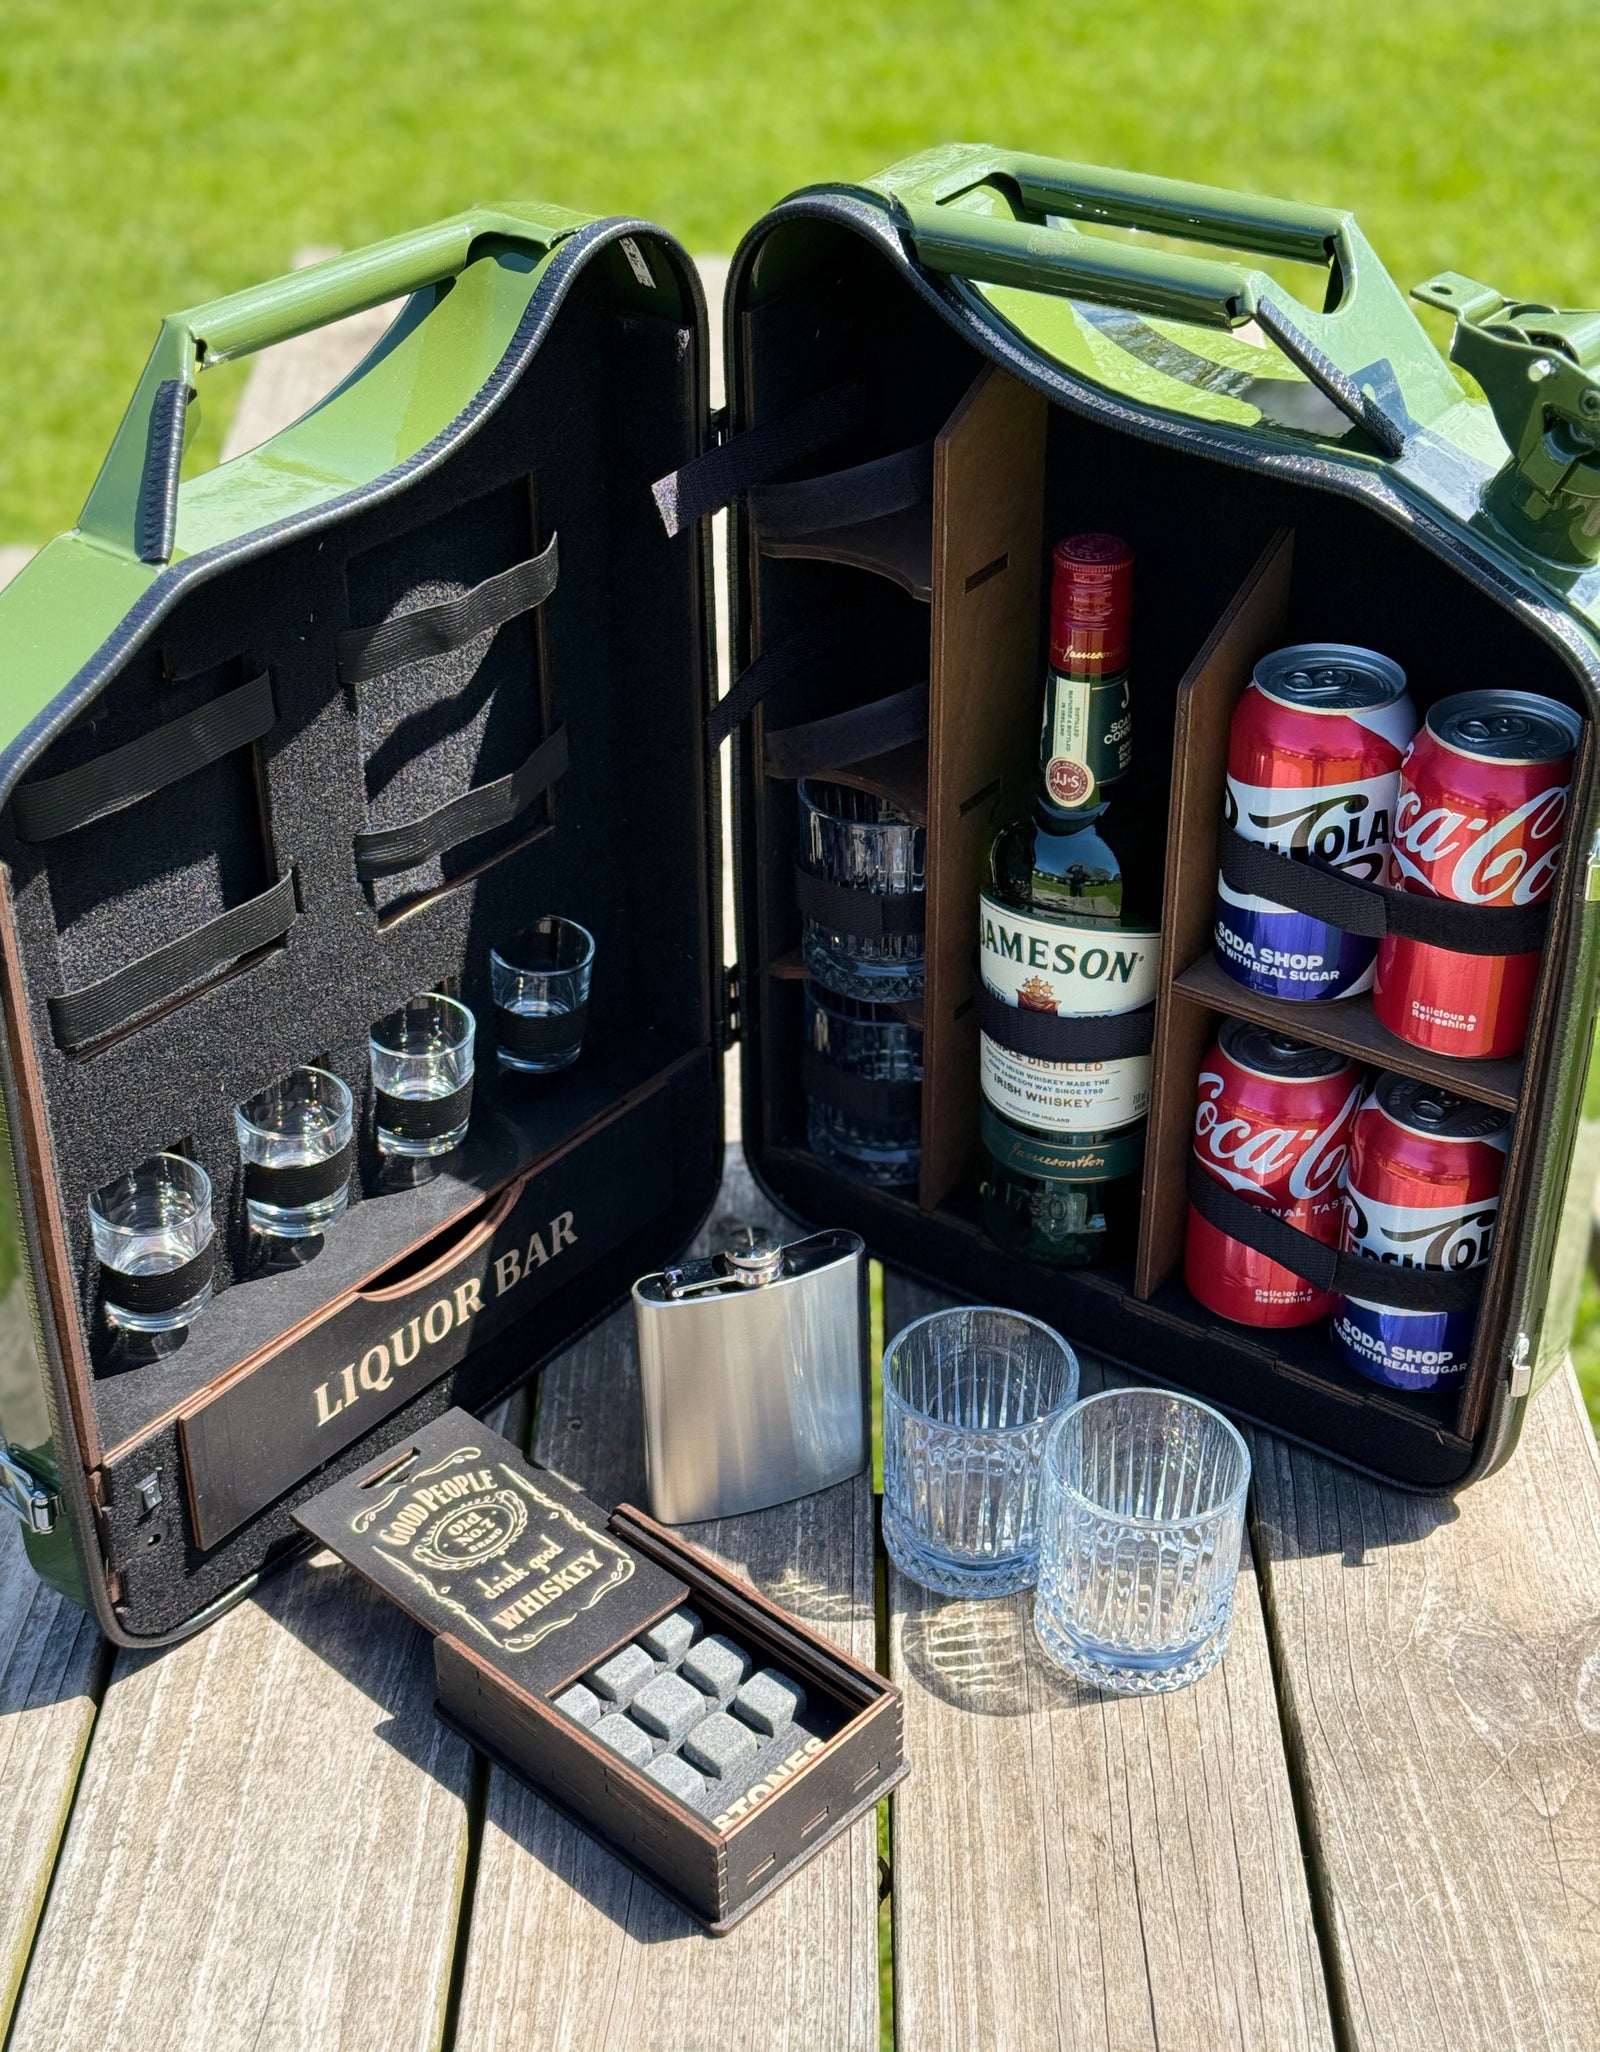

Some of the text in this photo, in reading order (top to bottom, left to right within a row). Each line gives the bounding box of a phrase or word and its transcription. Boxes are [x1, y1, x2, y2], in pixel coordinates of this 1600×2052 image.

[1218, 921, 1323, 970] SODA SHOP
[1226, 946, 1251, 969] WITH
[1252, 962, 1287, 979] REAL
[1289, 970, 1340, 982] SUGAR
[1411, 1009, 1475, 1032] Refreshing
[1412, 1000, 1477, 1023] Delicious &
[1006, 1064, 1025, 1076] IRISH
[1027, 1073, 1064, 1086] WHISKEY
[1028, 1056, 1103, 1072] DISTILLED
[993, 1072, 1093, 1108] IRISH WHISKEY
[1001, 1070, 1033, 1087] JAMESON
[1035, 1084, 1052, 1093] WAY
[1055, 1087, 1081, 1095] SINCE
[1005, 1101, 1031, 1116] PRODUCT
[1042, 1114, 1070, 1123] IRELAND
[1312, 1199, 1345, 1214] TAS
[1255, 1288, 1304, 1298] Delicious
[1255, 1295, 1312, 1304] Refreshing
[313, 1210, 579, 1427] LIQUOR BAR
[1342, 1317, 1454, 1366] SODA SHOP
[1353, 1342, 1382, 1364] WITH
[1383, 1358, 1419, 1374] REAL
[1421, 1362, 1468, 1375] SUGAR
[379, 1469, 498, 1546] GOOD PEOPLE
[448, 1512, 483, 1536] Old
[468, 1528, 504, 1553] BRAND
[476, 1534, 564, 1600] drink good
[492, 1549, 604, 1631] WHISKEY
[712, 1737, 826, 1831] STONES
